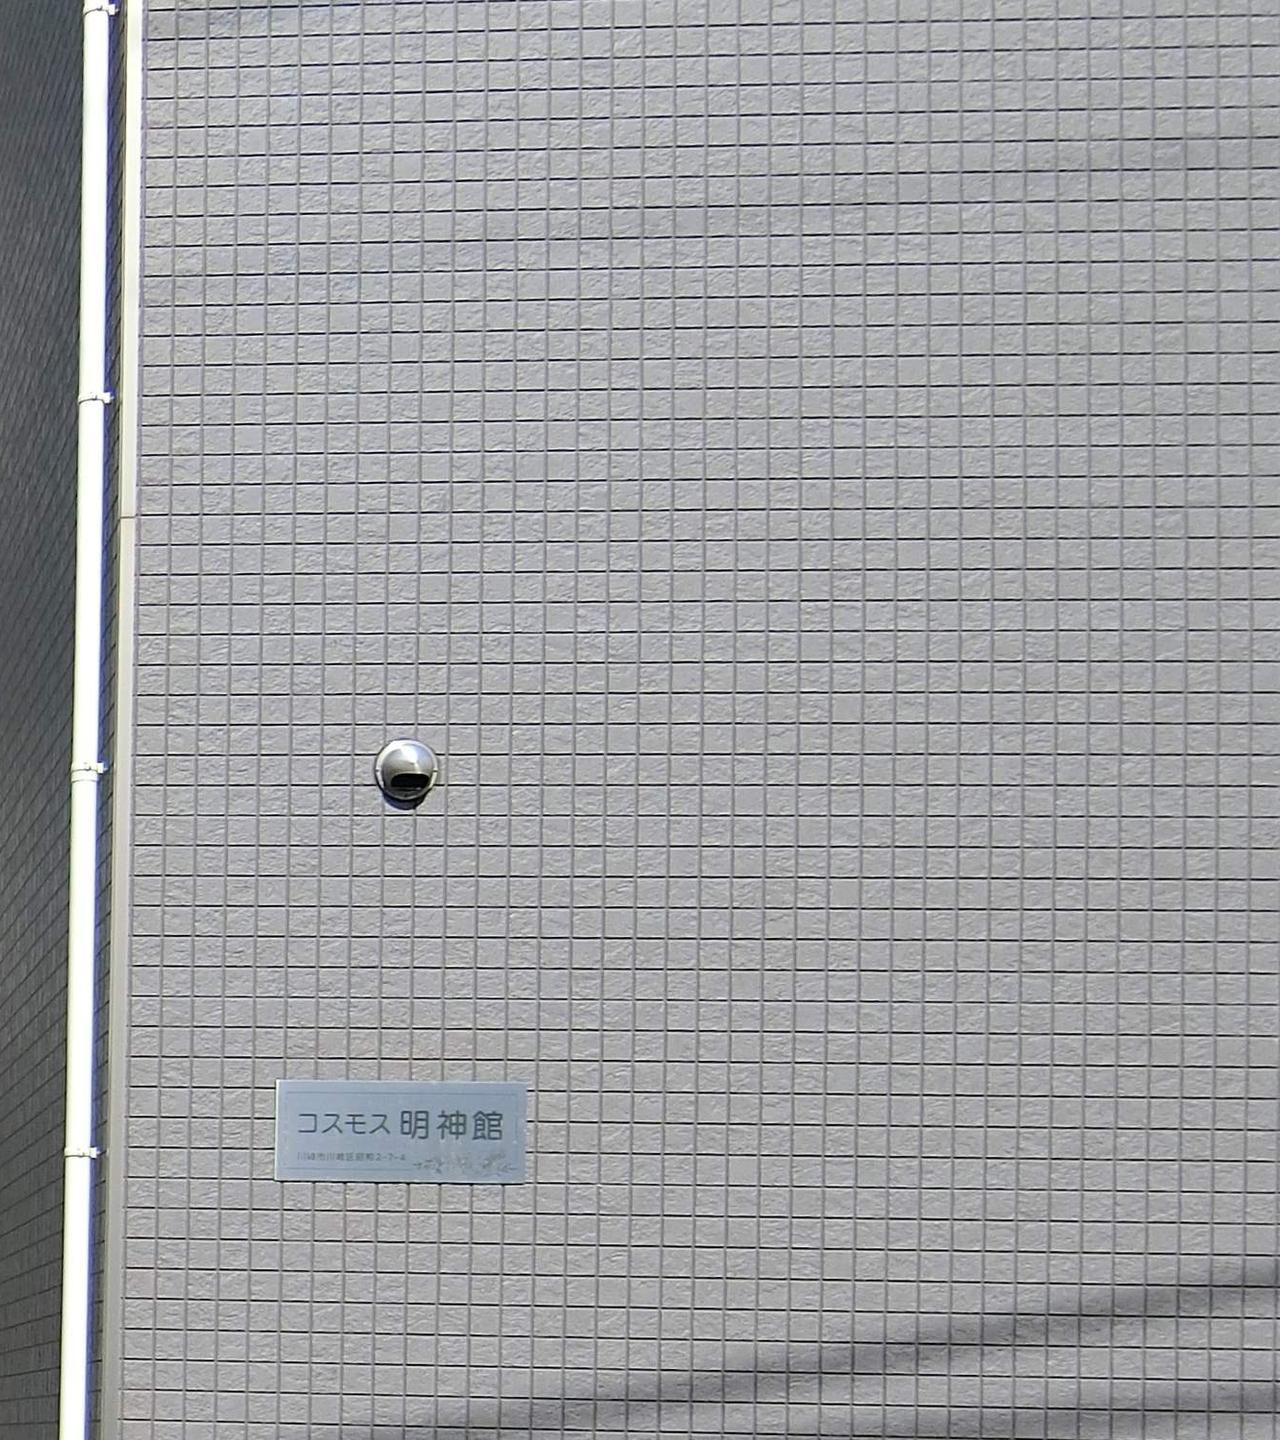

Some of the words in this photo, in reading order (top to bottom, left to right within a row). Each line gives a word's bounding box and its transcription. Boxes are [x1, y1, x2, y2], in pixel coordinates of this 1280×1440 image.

[298, 1109, 503, 1141] コスモス明神館
